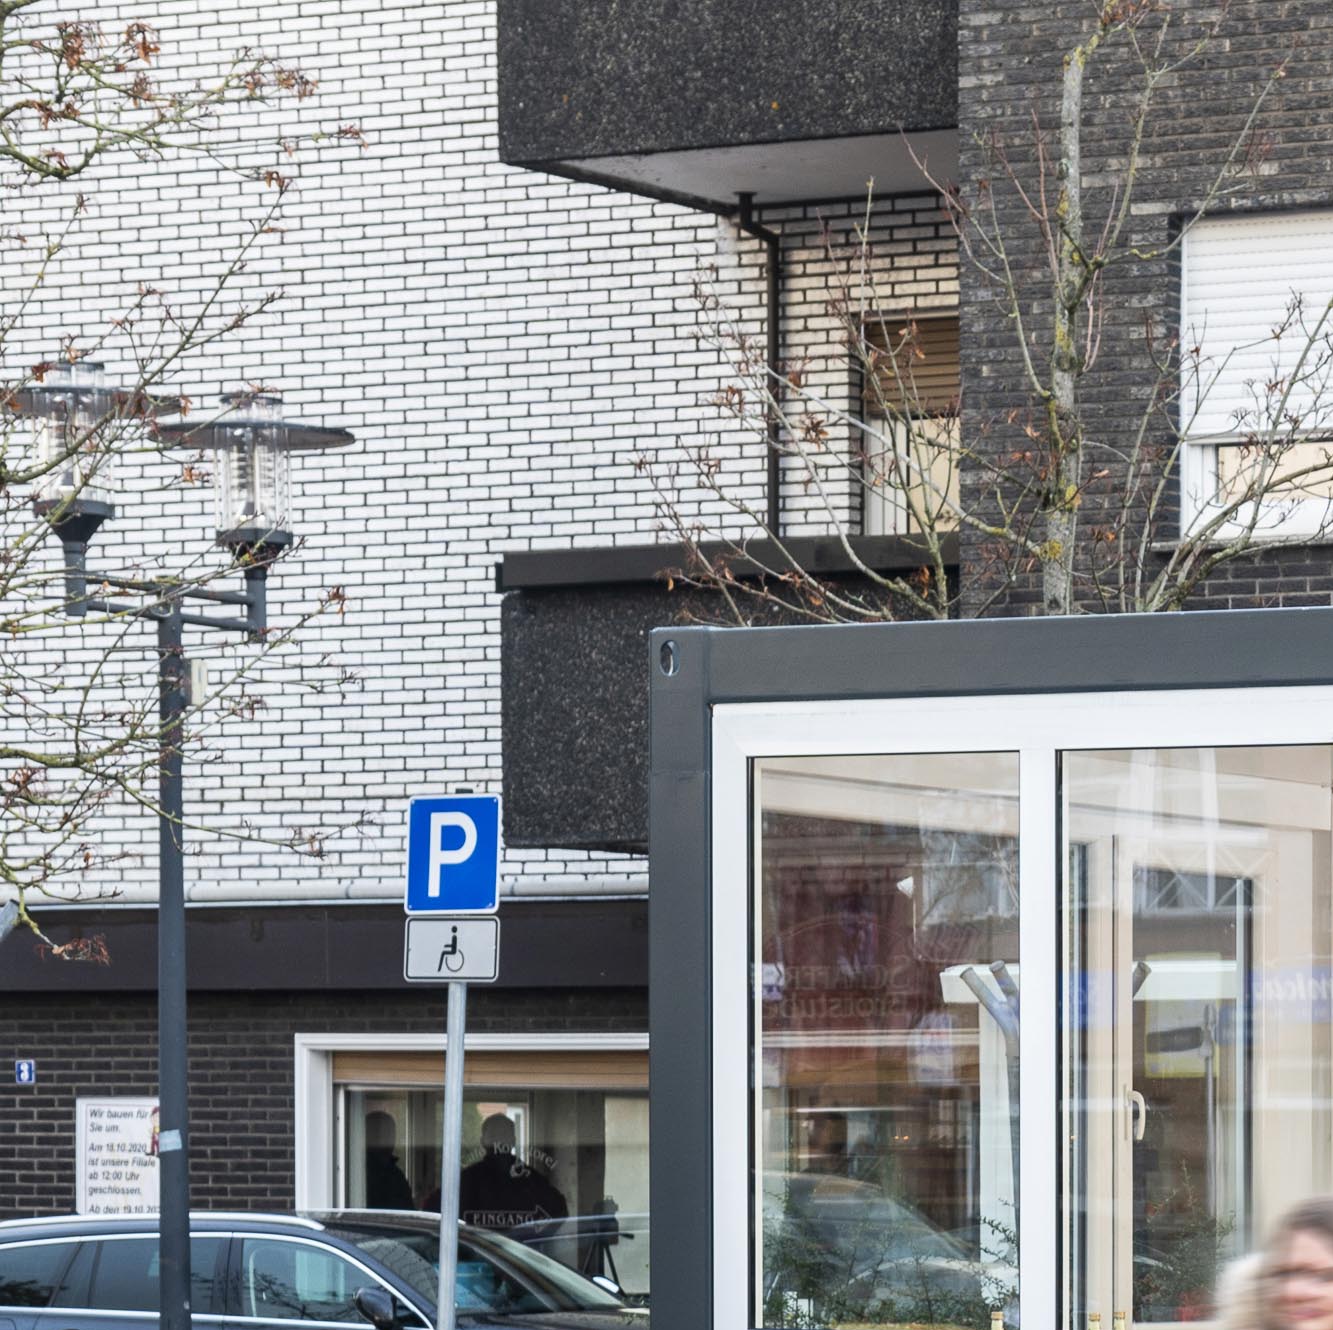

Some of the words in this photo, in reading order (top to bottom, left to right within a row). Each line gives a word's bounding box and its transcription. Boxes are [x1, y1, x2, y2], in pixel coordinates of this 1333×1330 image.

[428, 811, 478, 897] P
[89, 1109, 104, 1118] Wir
[107, 1110, 133, 1119] bauen
[136, 1110, 149, 1119] für
[89, 1122, 103, 1132] Sie
[89, 1142, 103, 1152] Am
[88, 1158, 99, 1166] ist
[101, 1159, 129, 1167] unsere
[131, 1157, 156, 1168] Filiale
[88, 1171, 98, 1180] ab
[102, 1171, 122, 1180] 12:00
[124, 1171, 140, 1181] Uhr
[89, 1204, 100, 1213] Ab
[103, 1204, 119, 1213] den
